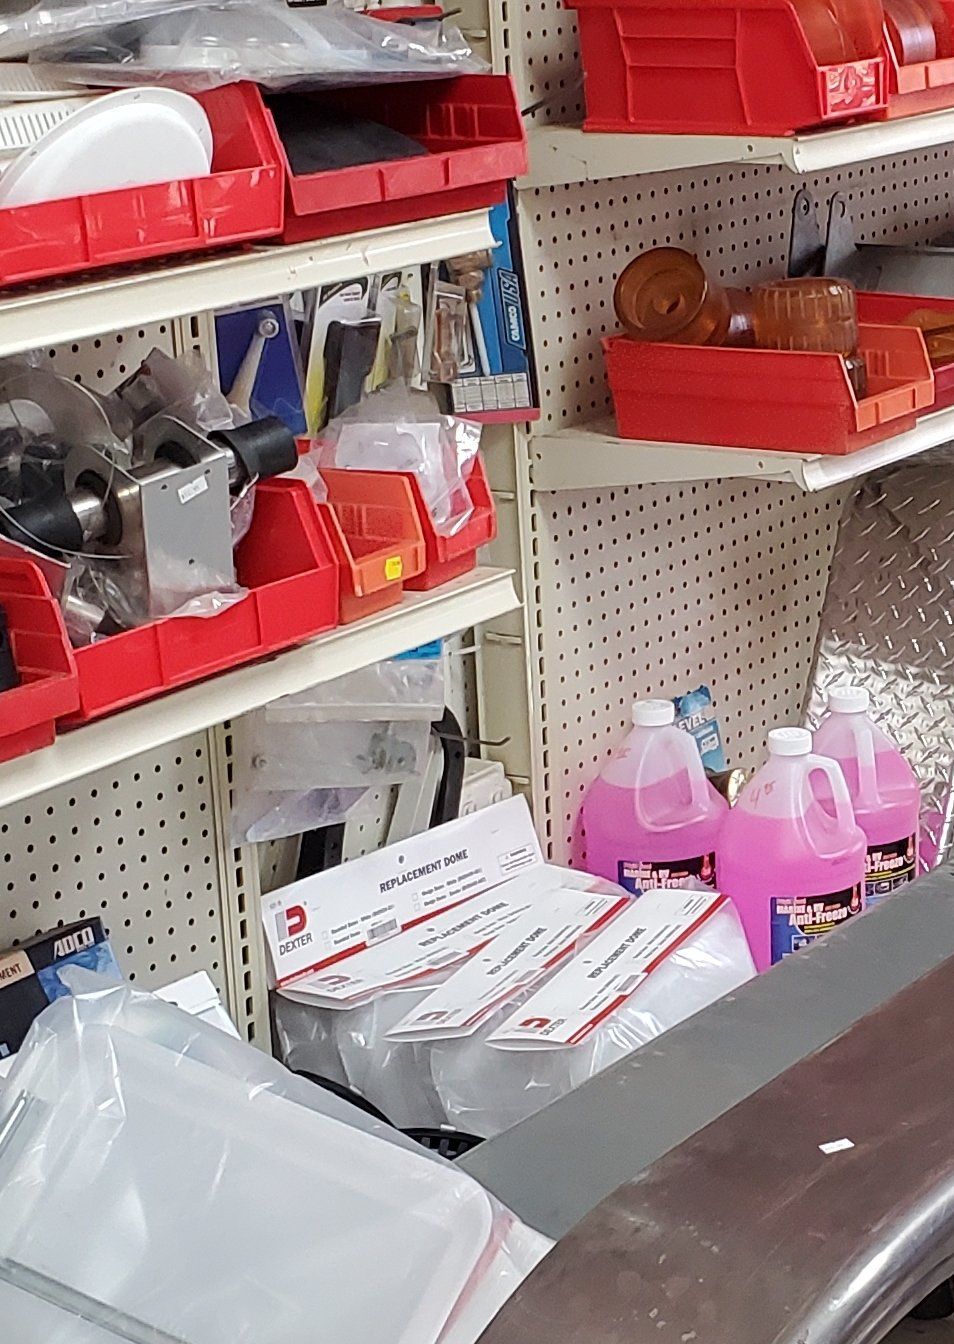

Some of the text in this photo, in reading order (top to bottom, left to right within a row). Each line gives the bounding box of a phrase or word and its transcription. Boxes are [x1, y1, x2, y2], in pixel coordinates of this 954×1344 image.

[679, 712, 706, 731] EVEL
[379, 860, 441, 893] REPLACEMENT
[444, 849, 469, 867] DOME
[789, 907, 848, 926] Anti-Freeze
[53, 926, 95, 960] ADCO
[279, 932, 313, 956] DEXTER
[0, 963, 22, 981] MENT
